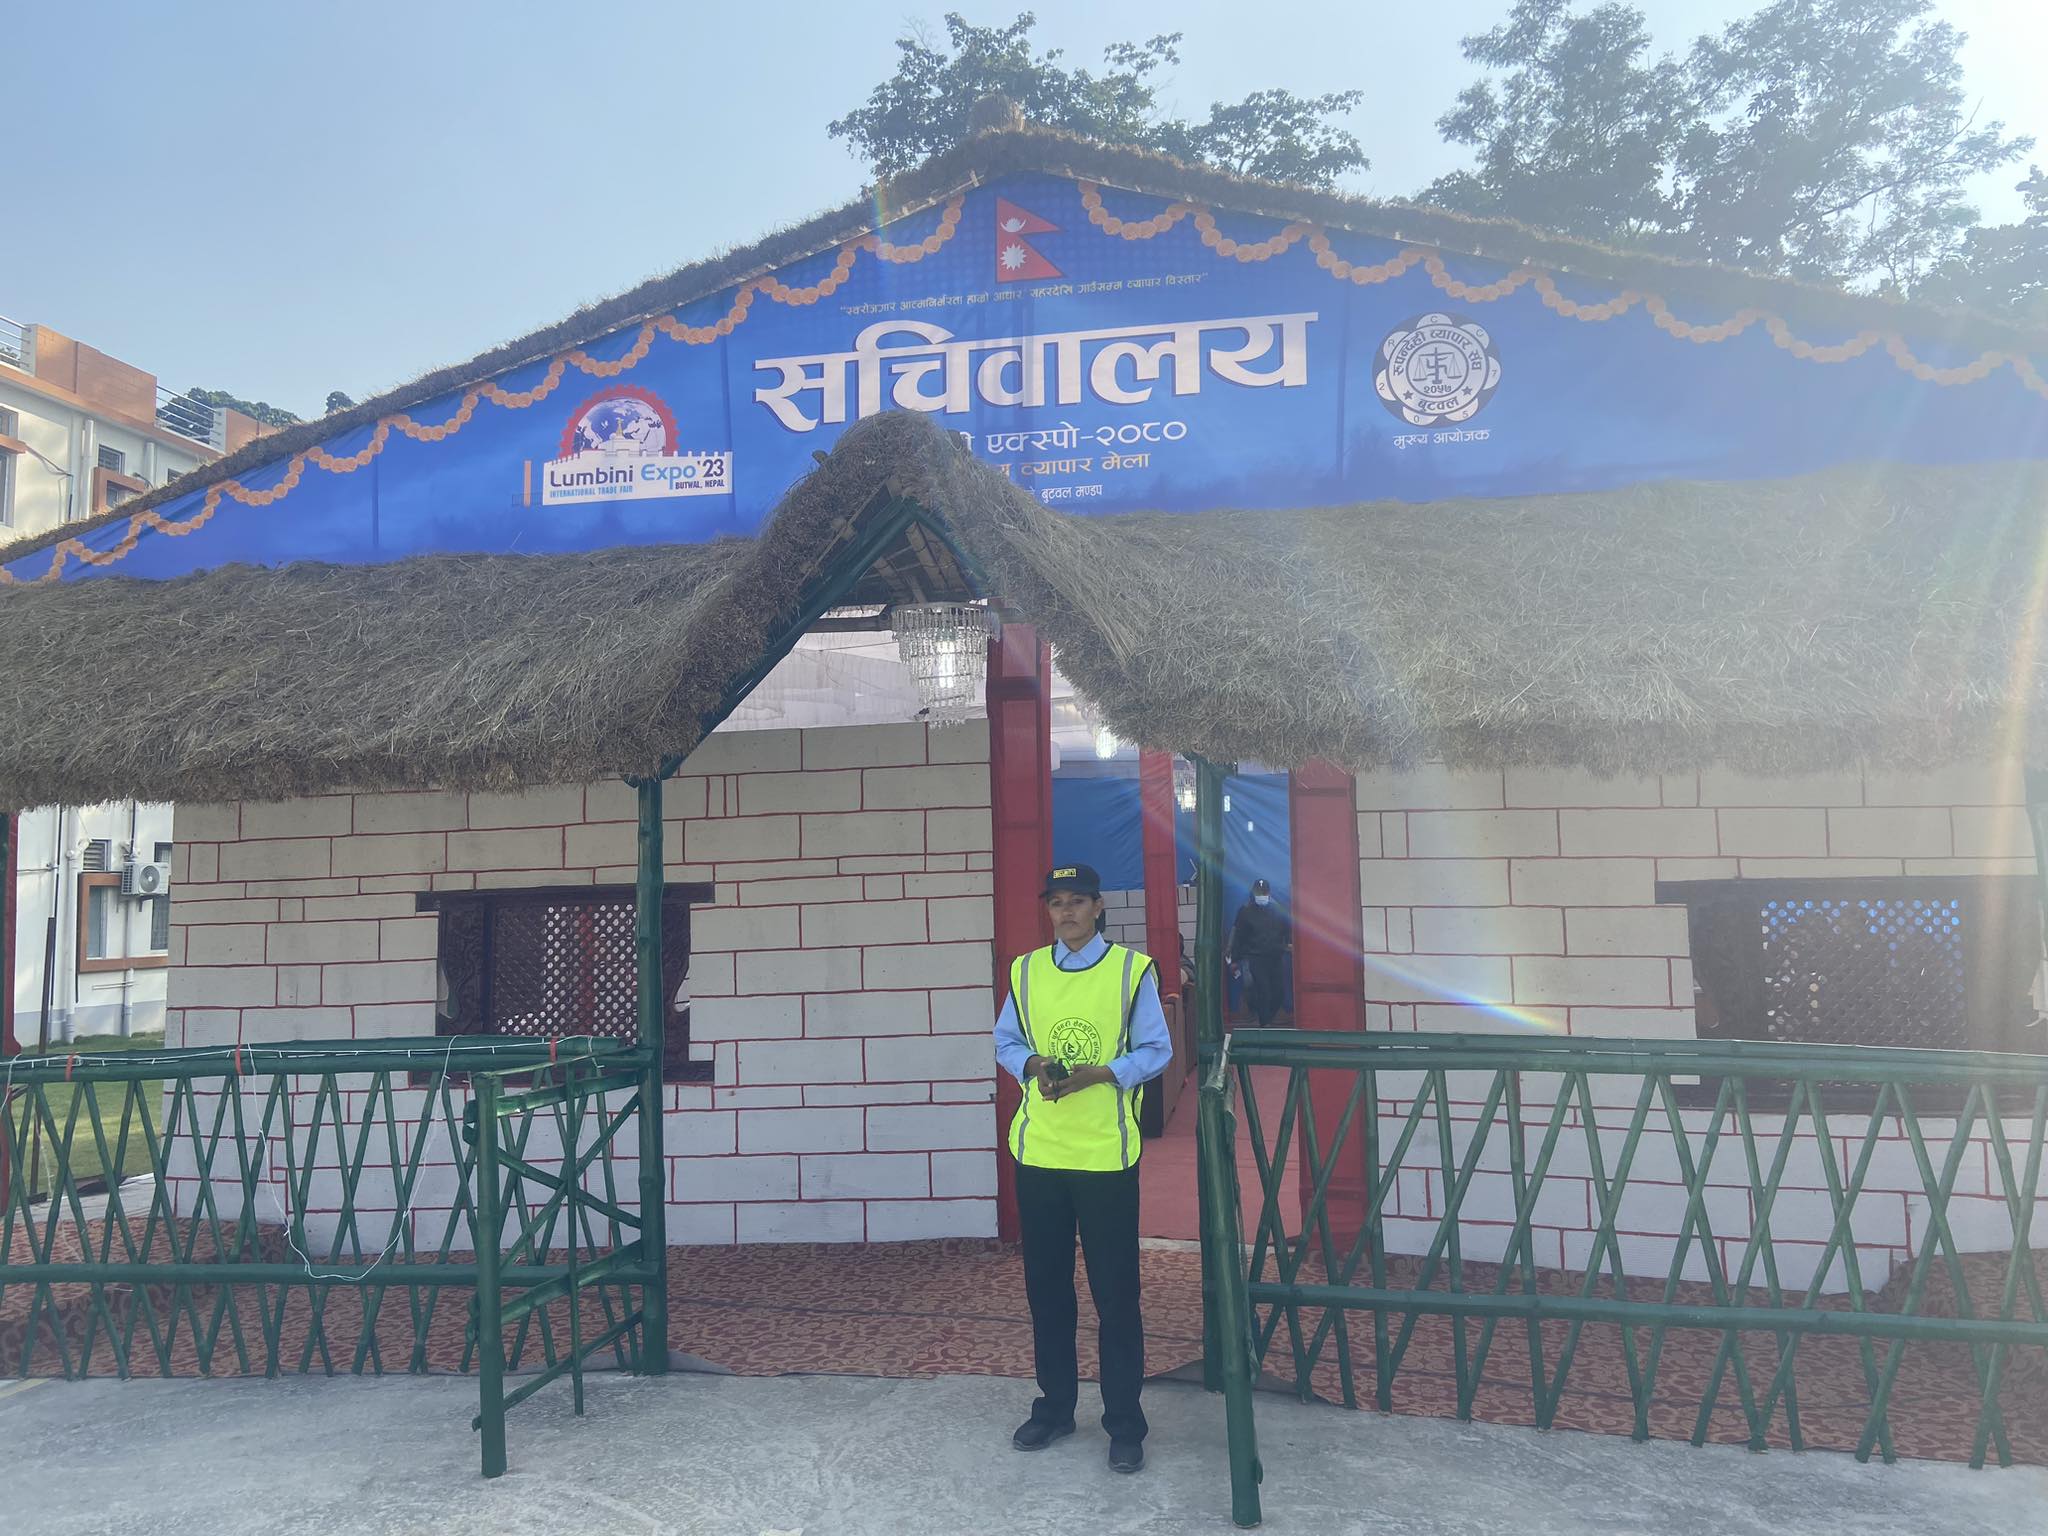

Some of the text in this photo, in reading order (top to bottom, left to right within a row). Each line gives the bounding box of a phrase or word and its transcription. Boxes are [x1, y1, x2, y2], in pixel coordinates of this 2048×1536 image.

[1127, 278, 1162, 290] व्यापार
[1430, 329, 1472, 350] व्यापार
[755, 312, 1318, 432] सचिवालय
[986, 421, 1188, 453] एक्स्पो-२०८०
[1392, 428, 1491, 449] मुख्य आयोजक
[1021, 457, 1093, 476] व्यापार
[1101, 452, 1151, 470] मेला
[550, 465, 633, 487] Lumbini
[705, 479, 725, 488] NEPAL
[550, 485, 633, 498] INTERNATIONAL TRADE FAIR
[1041, 485, 1072, 503] बुटवल
[1075, 484, 1103, 498] मण्डप
